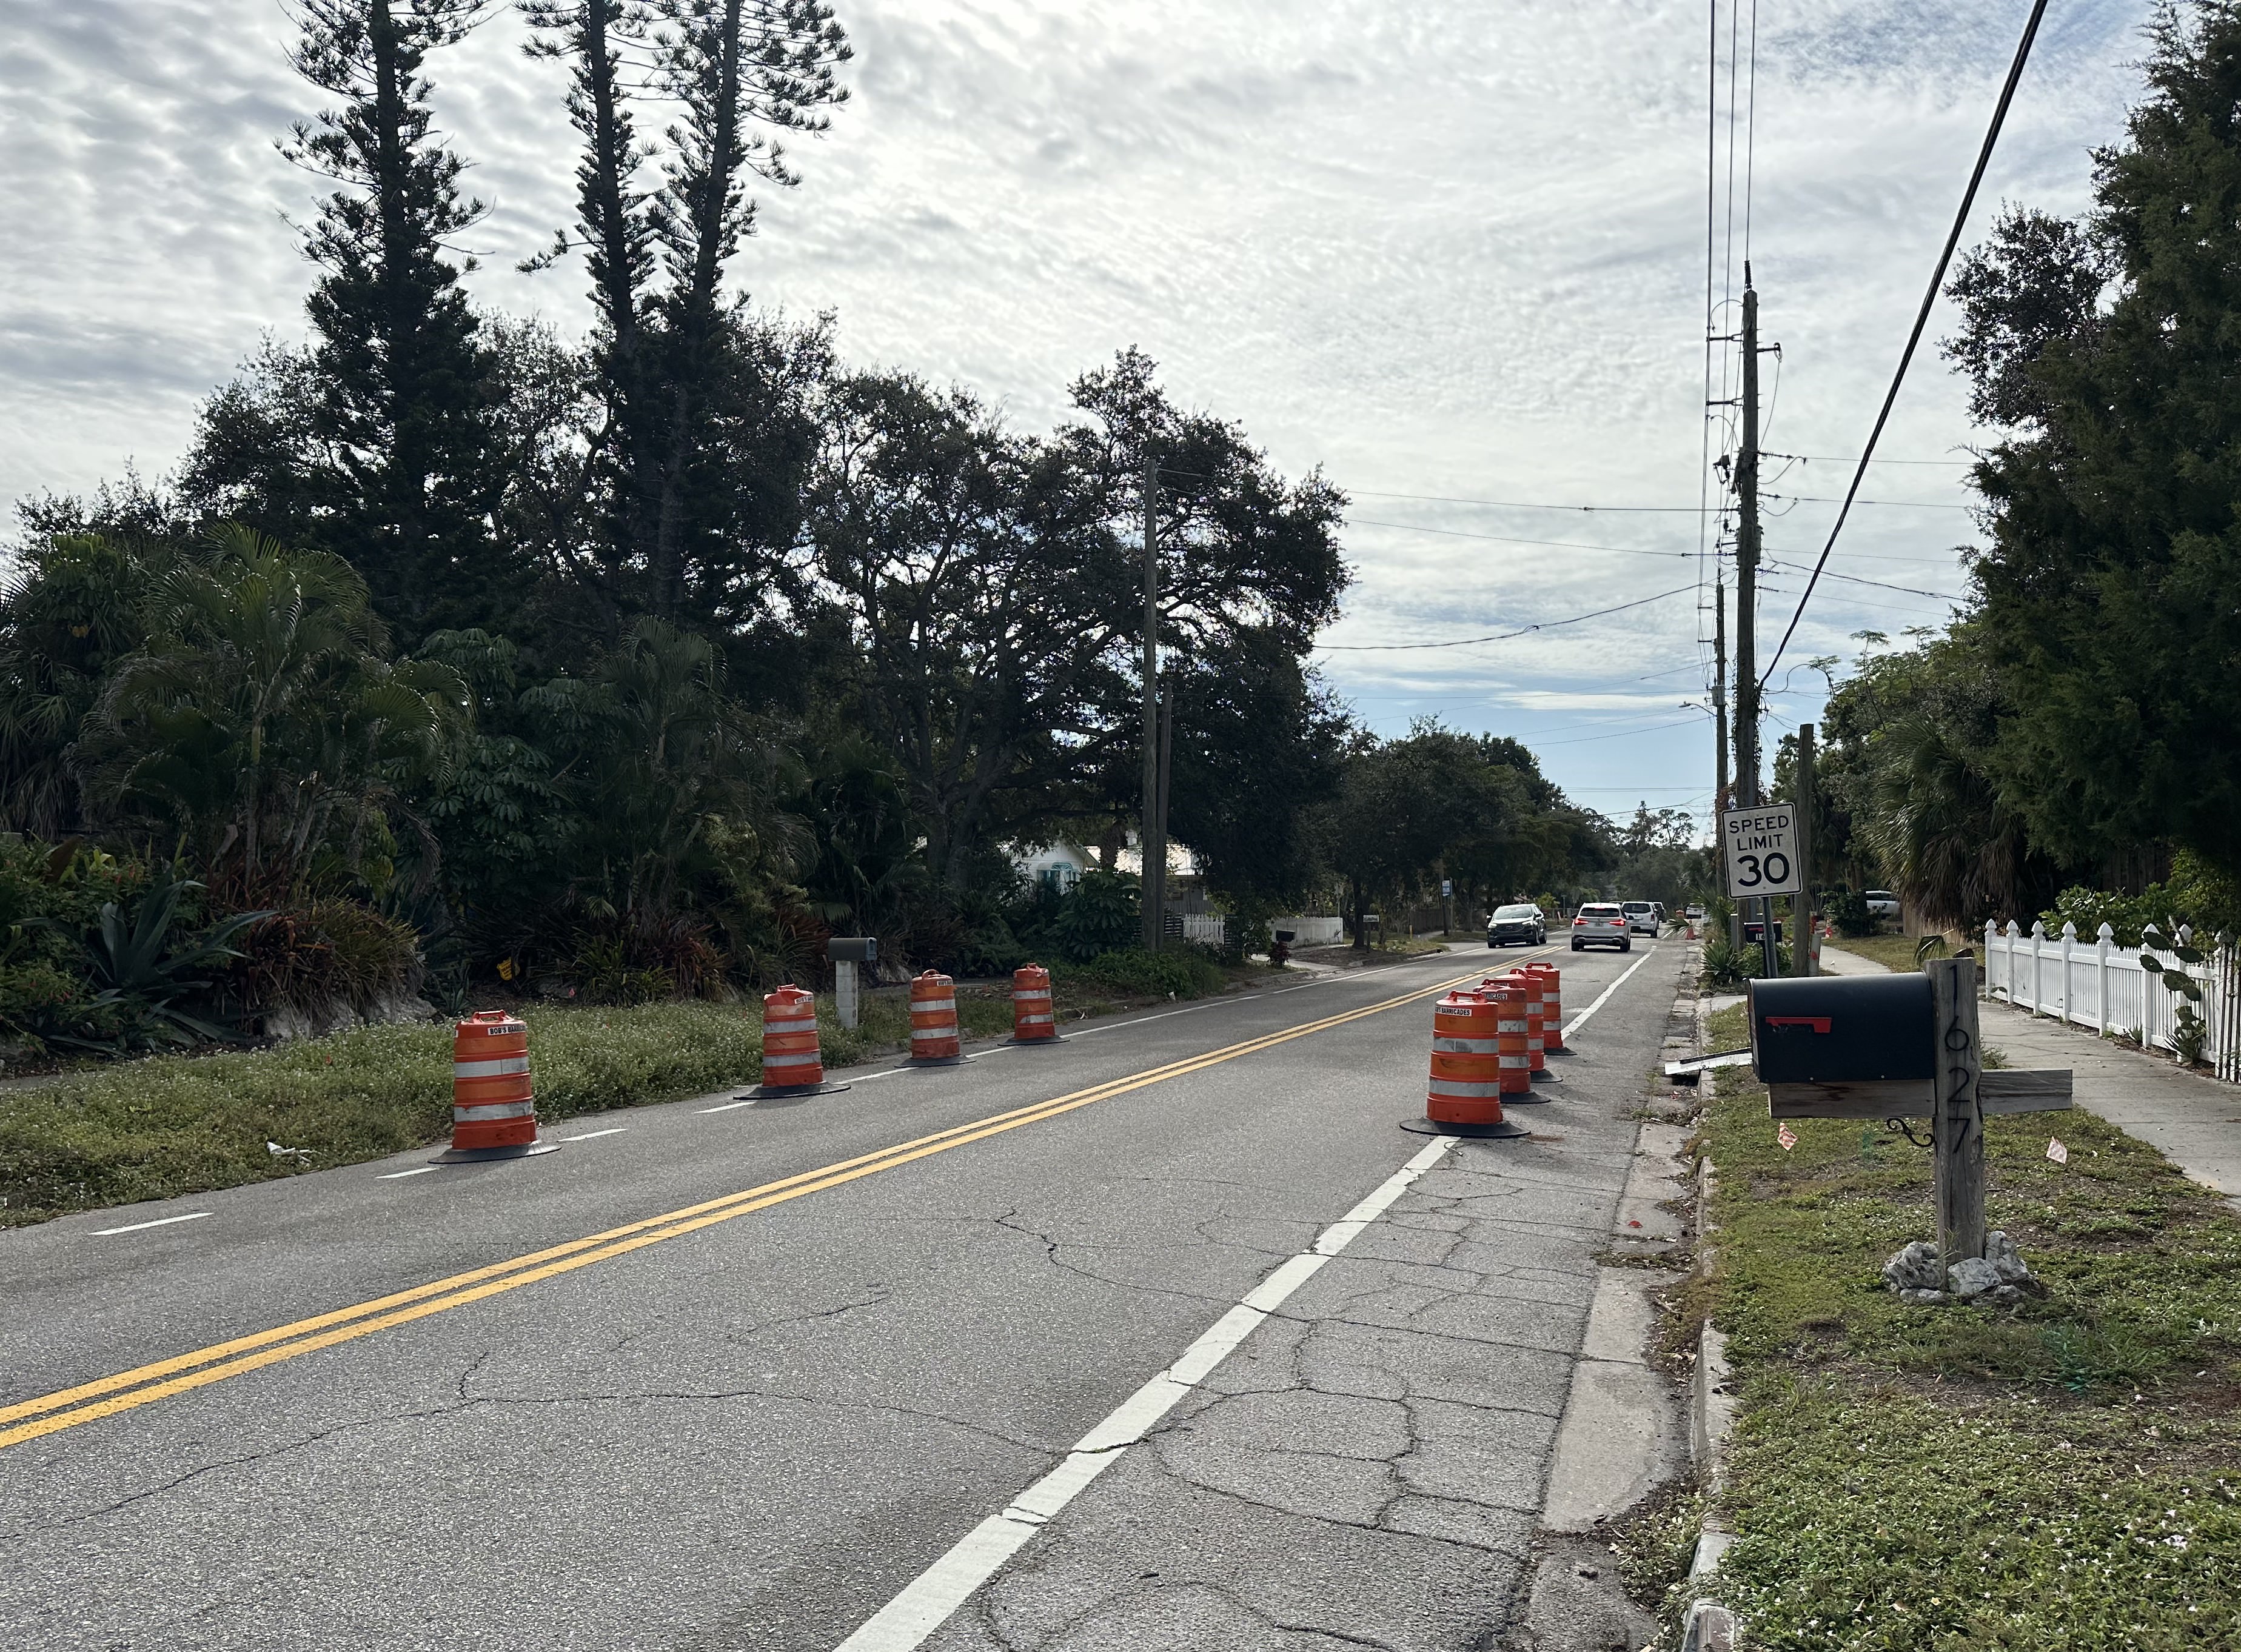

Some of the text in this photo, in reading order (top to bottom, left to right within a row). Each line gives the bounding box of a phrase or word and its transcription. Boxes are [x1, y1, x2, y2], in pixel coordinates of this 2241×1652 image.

[1729, 815, 1789, 834] SPEED
[1737, 834, 1783, 851] LIMIT
[1737, 852, 1790, 887] 30
[1945, 964, 1971, 1154] 1627
